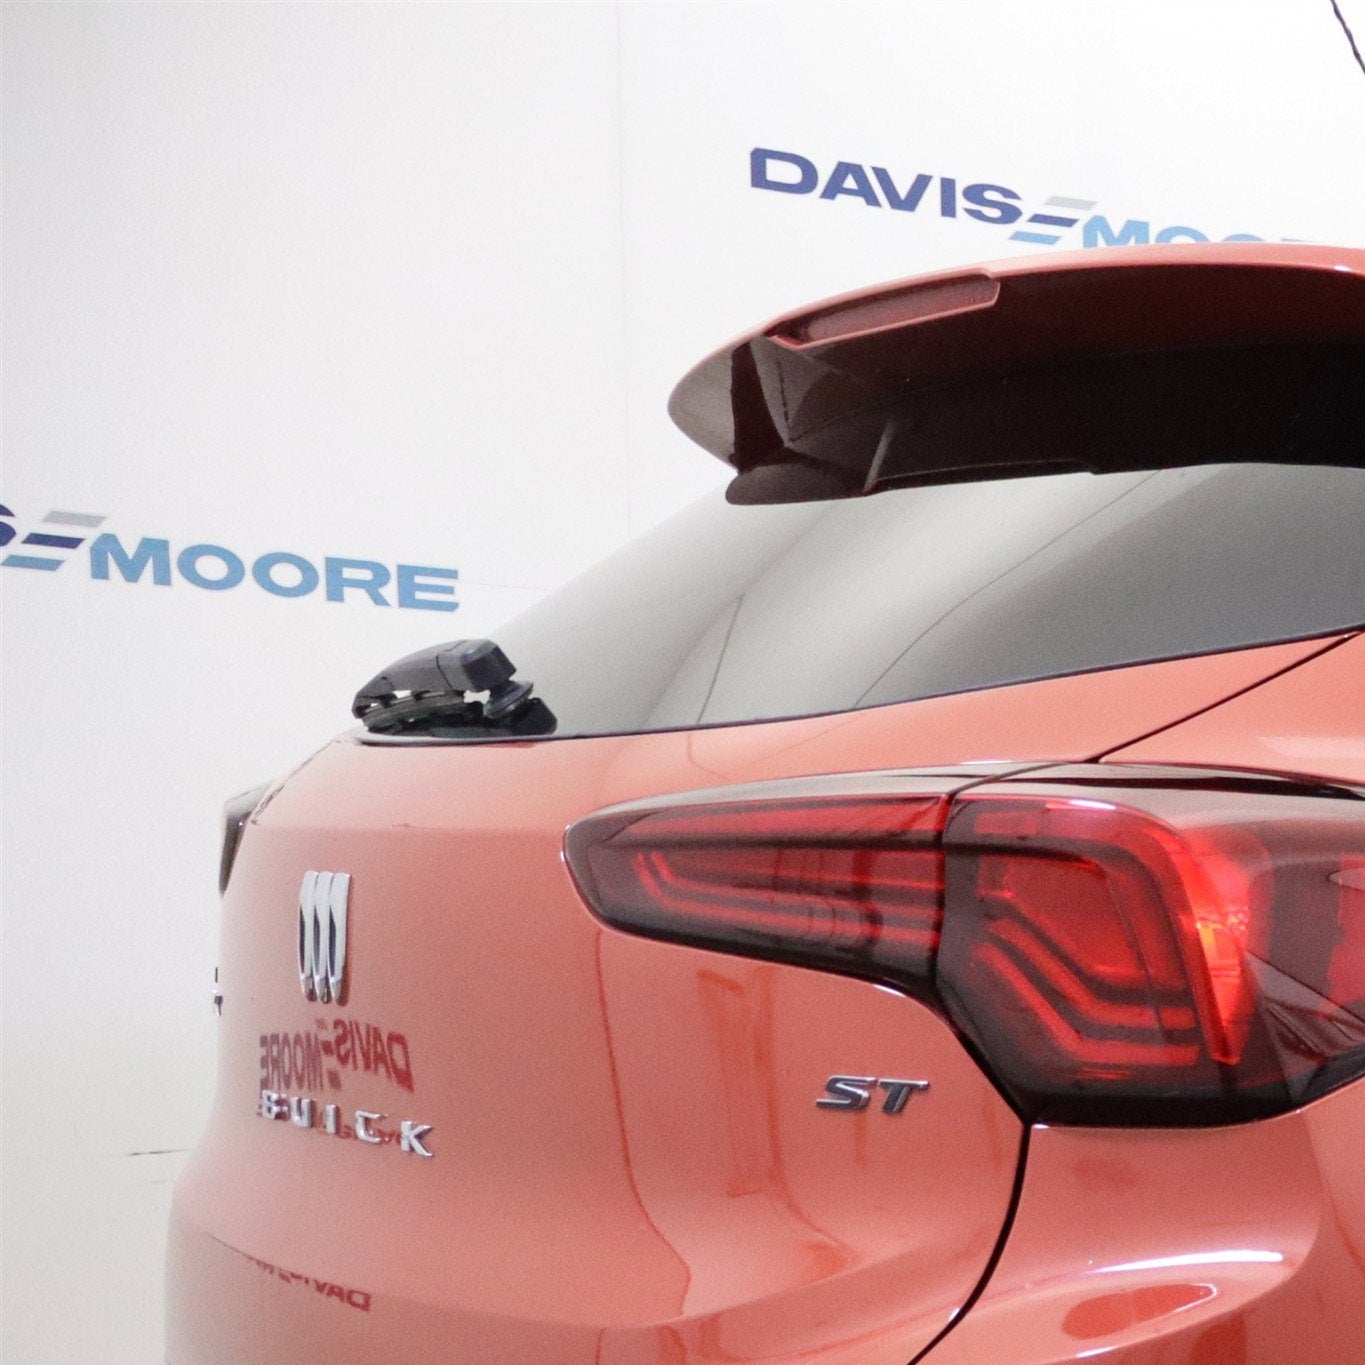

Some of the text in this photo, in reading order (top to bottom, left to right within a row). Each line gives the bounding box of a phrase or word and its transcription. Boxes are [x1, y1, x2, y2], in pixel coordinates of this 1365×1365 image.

[749, 146, 1023, 226] DAVIS
[89, 532, 460, 612] MOORE
[257, 1089, 435, 1158] BUICK
[815, 1074, 931, 1115] ST
